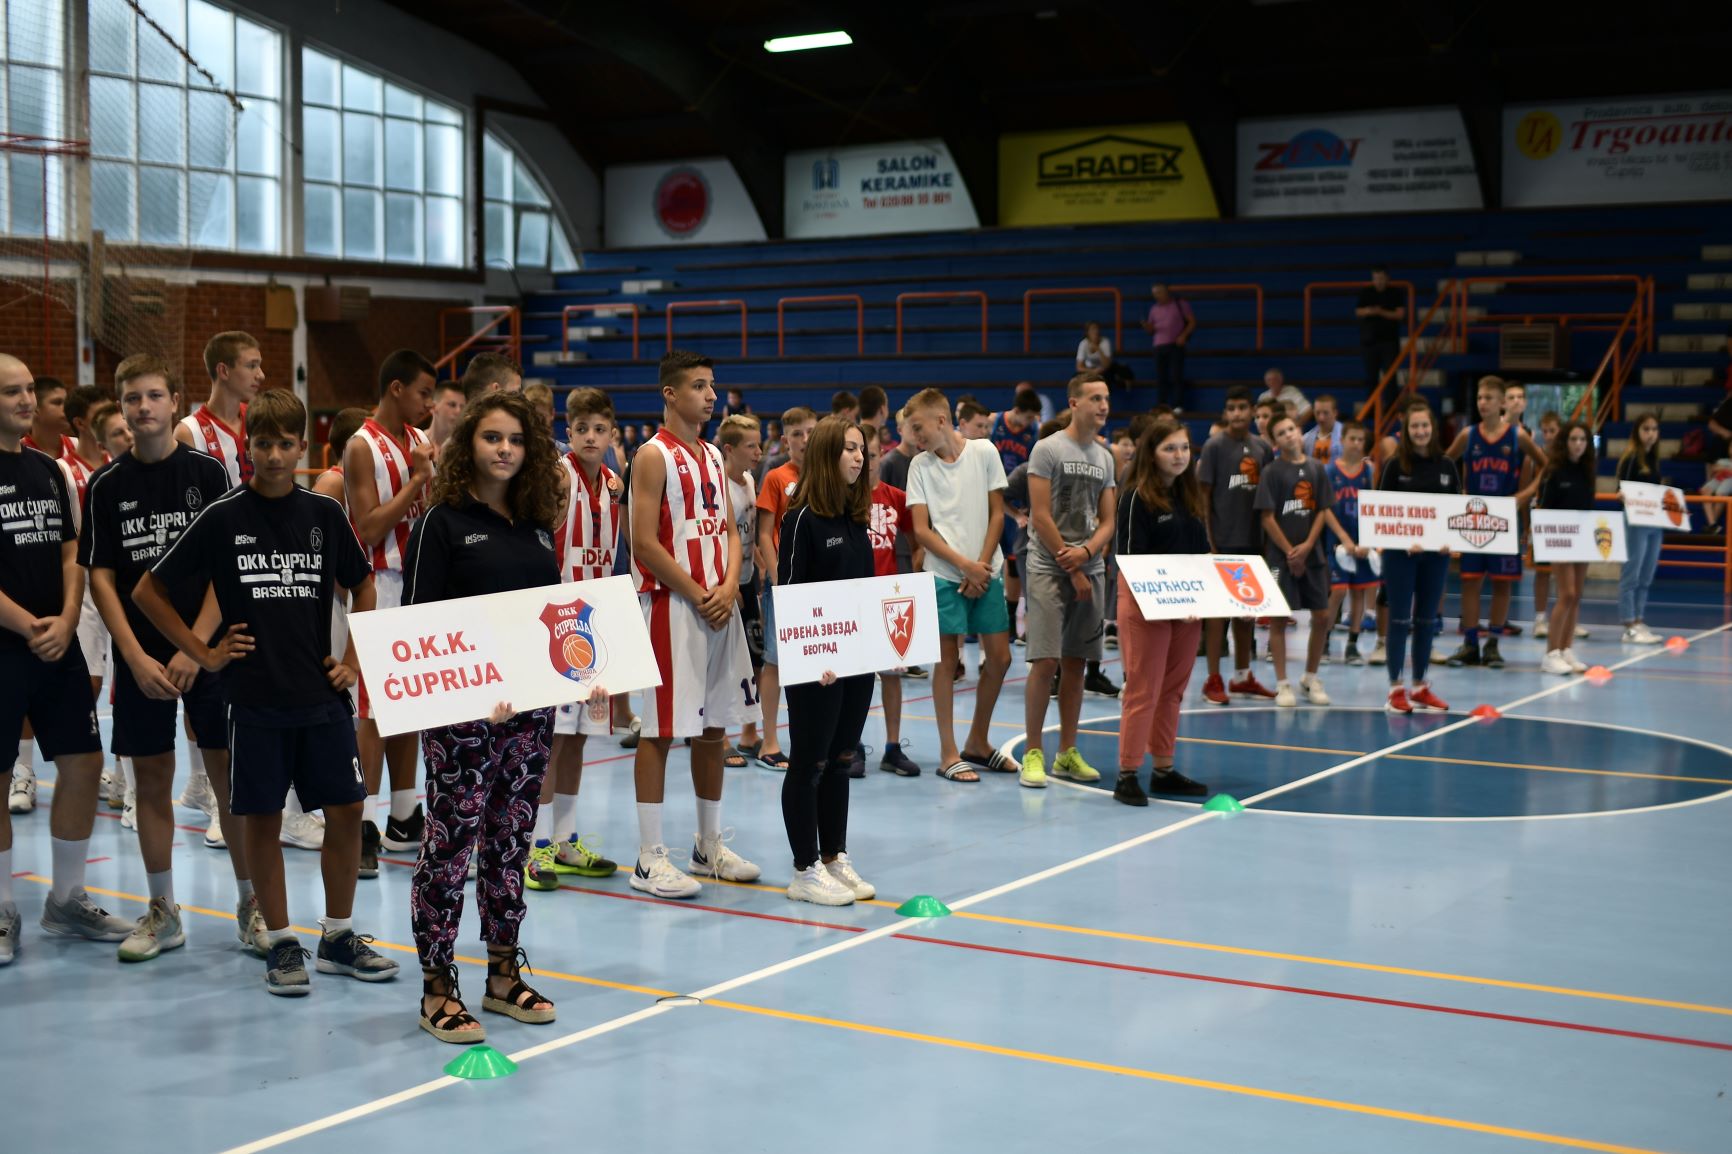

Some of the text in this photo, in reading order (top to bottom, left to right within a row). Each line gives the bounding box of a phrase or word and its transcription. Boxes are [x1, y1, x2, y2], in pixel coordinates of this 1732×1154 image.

[877, 155, 937, 174] SALON
[1039, 151, 1183, 179] GRADEX
[861, 172, 953, 192] KERAMIKE
[1063, 462, 1076, 475] GET
[1471, 456, 1510, 474] VIVA
[701, 482, 719, 510] 12
[1335, 486, 1359, 500] VIV
[0, 501, 26, 519] OKK
[1360, 504, 1437, 520] KK KRIS KROS
[121, 510, 200, 536] OKK ĆUPRI
[1374, 521, 1424, 537] PANČEVO
[1449, 514, 1508, 531] KRIS KROS
[237, 549, 323, 571] OKK ĆUPRIJA
[1131, 580, 1205, 595] БУДУЋНОСТ
[558, 606, 578, 617] OKK
[812, 607, 823, 618] КК
[554, 618, 593, 640] ĆUPRIJA
[779, 624, 819, 644] ЦРВЕНА
[821, 619, 858, 637] ЗВЕЗДА
[391, 630, 477, 663] O.K.K.
[803, 641, 838, 656] БЕОГРАД
[383, 662, 504, 701] ĆUPRIJA
